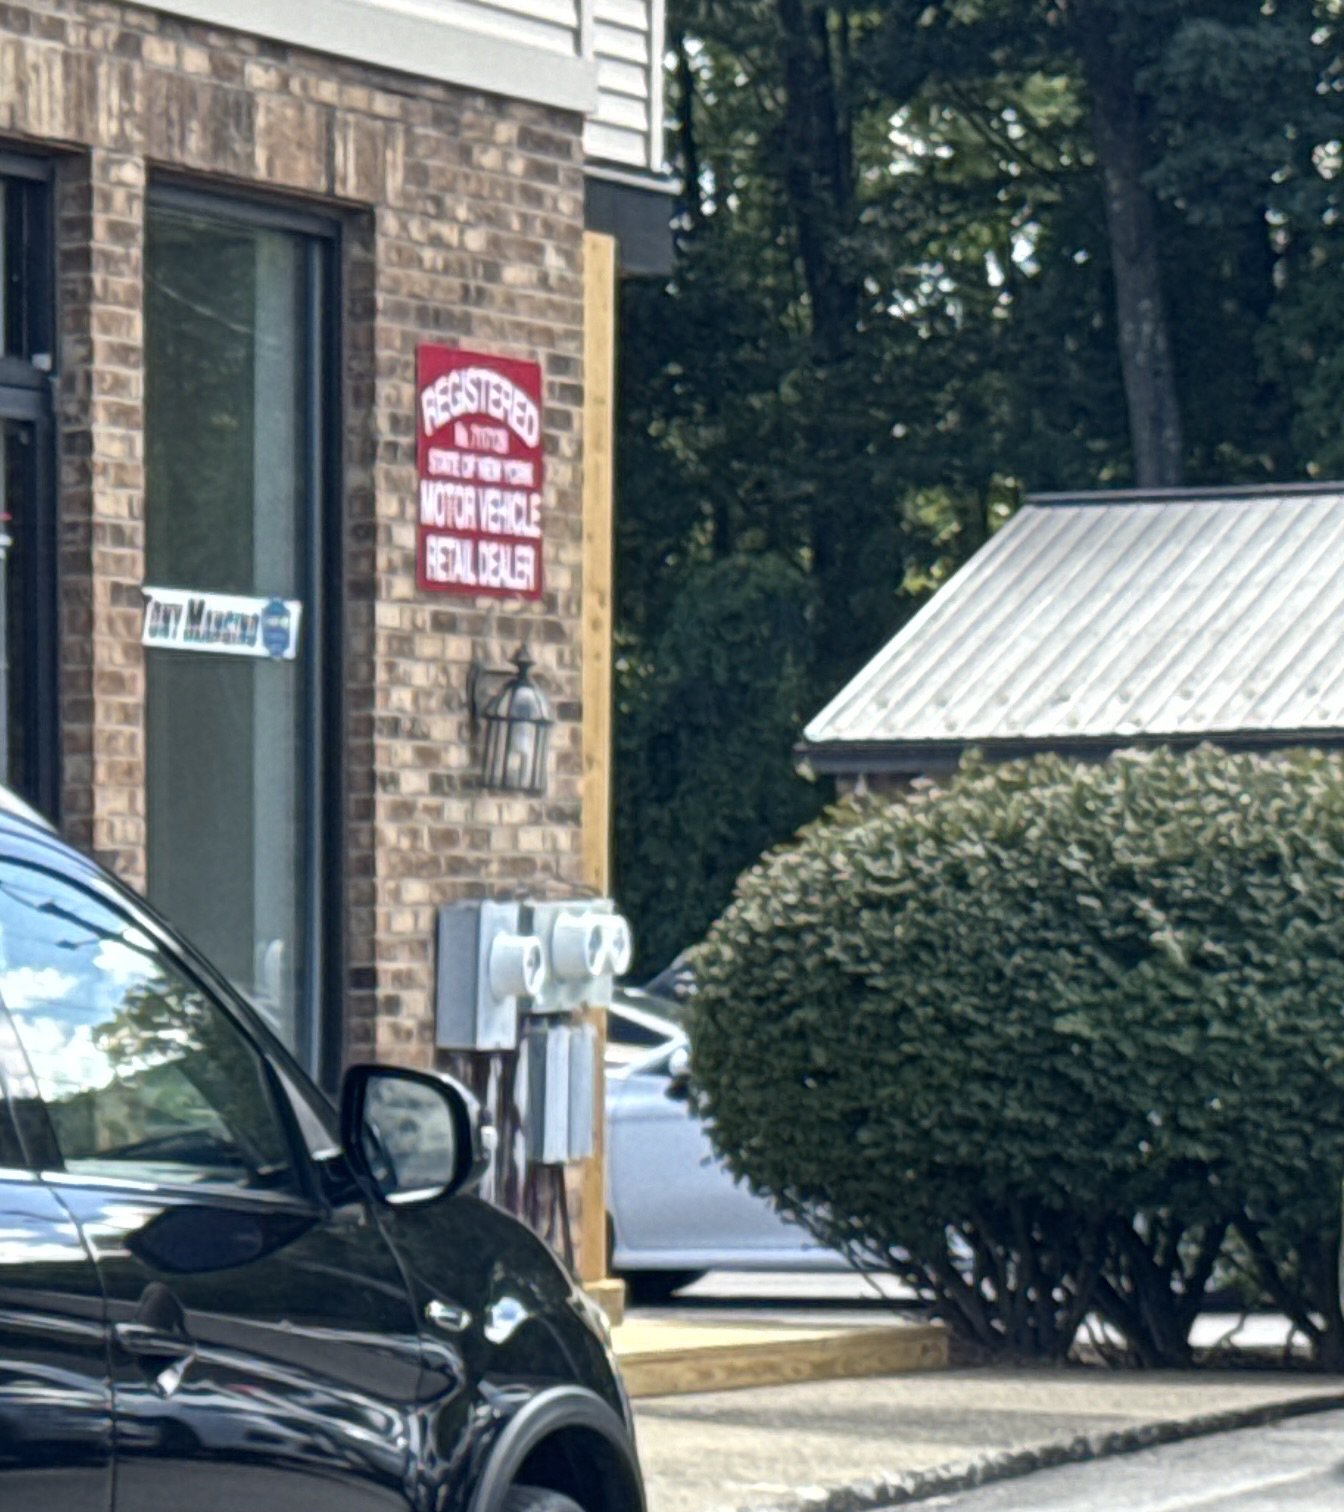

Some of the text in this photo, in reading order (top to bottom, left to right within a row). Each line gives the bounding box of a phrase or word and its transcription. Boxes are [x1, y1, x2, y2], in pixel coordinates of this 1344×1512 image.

[421, 367, 540, 449] REGISTERED
[420, 479, 541, 538] MOTOR VEHICLE
[426, 534, 535, 592] RETAIL DEALER
